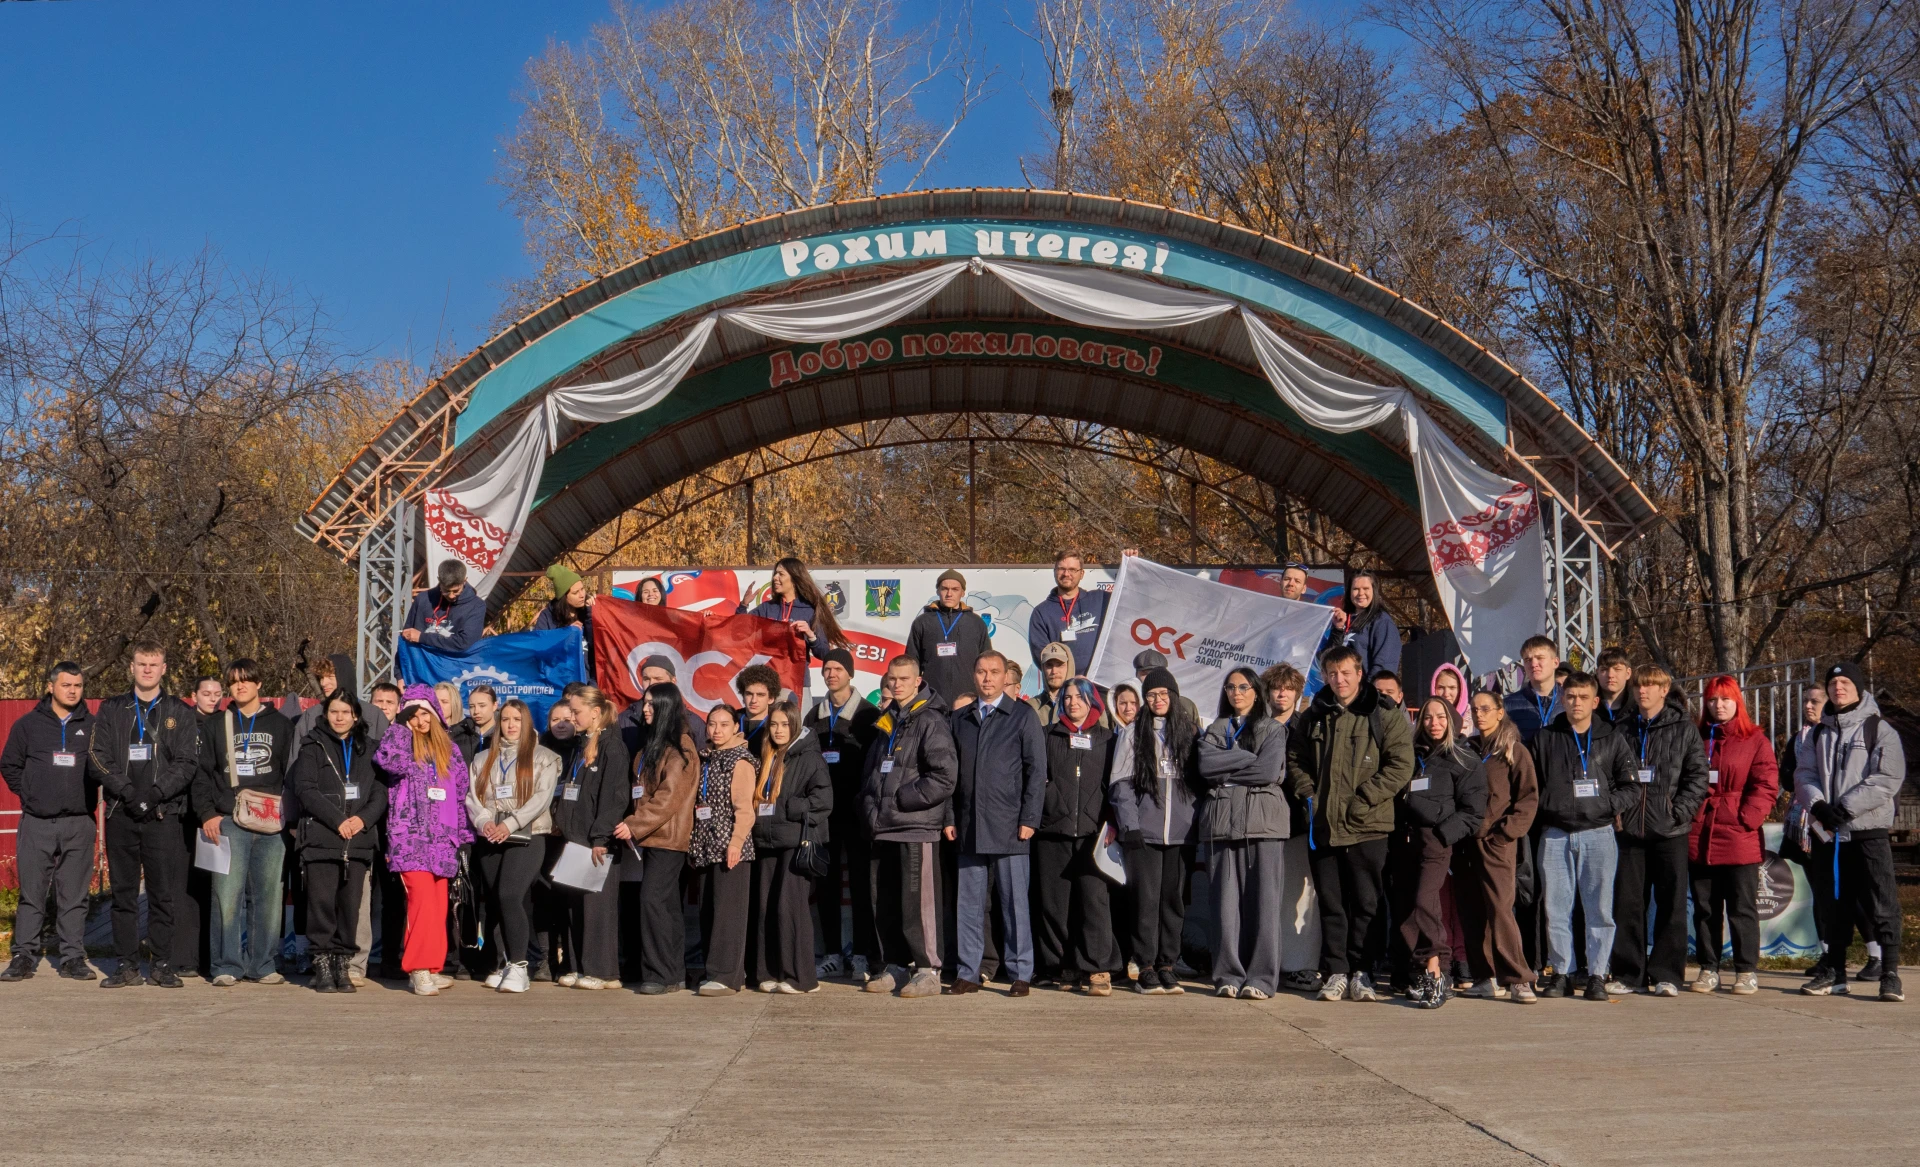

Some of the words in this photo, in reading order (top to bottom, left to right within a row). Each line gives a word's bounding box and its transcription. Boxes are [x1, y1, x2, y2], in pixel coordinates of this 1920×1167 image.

[769, 338, 893, 388] Добро
[902, 332, 1162, 376] пожаловать!
[1131, 618, 1194, 660] ОСК
[1200, 637, 1245, 653] АМУРСКИЙ
[1195, 655, 1222, 669] ЗАВОД
[1198, 646, 1281, 668] СУДОСТРОИТЕЛЬН
[910, 874, 919, 892] NEXT
